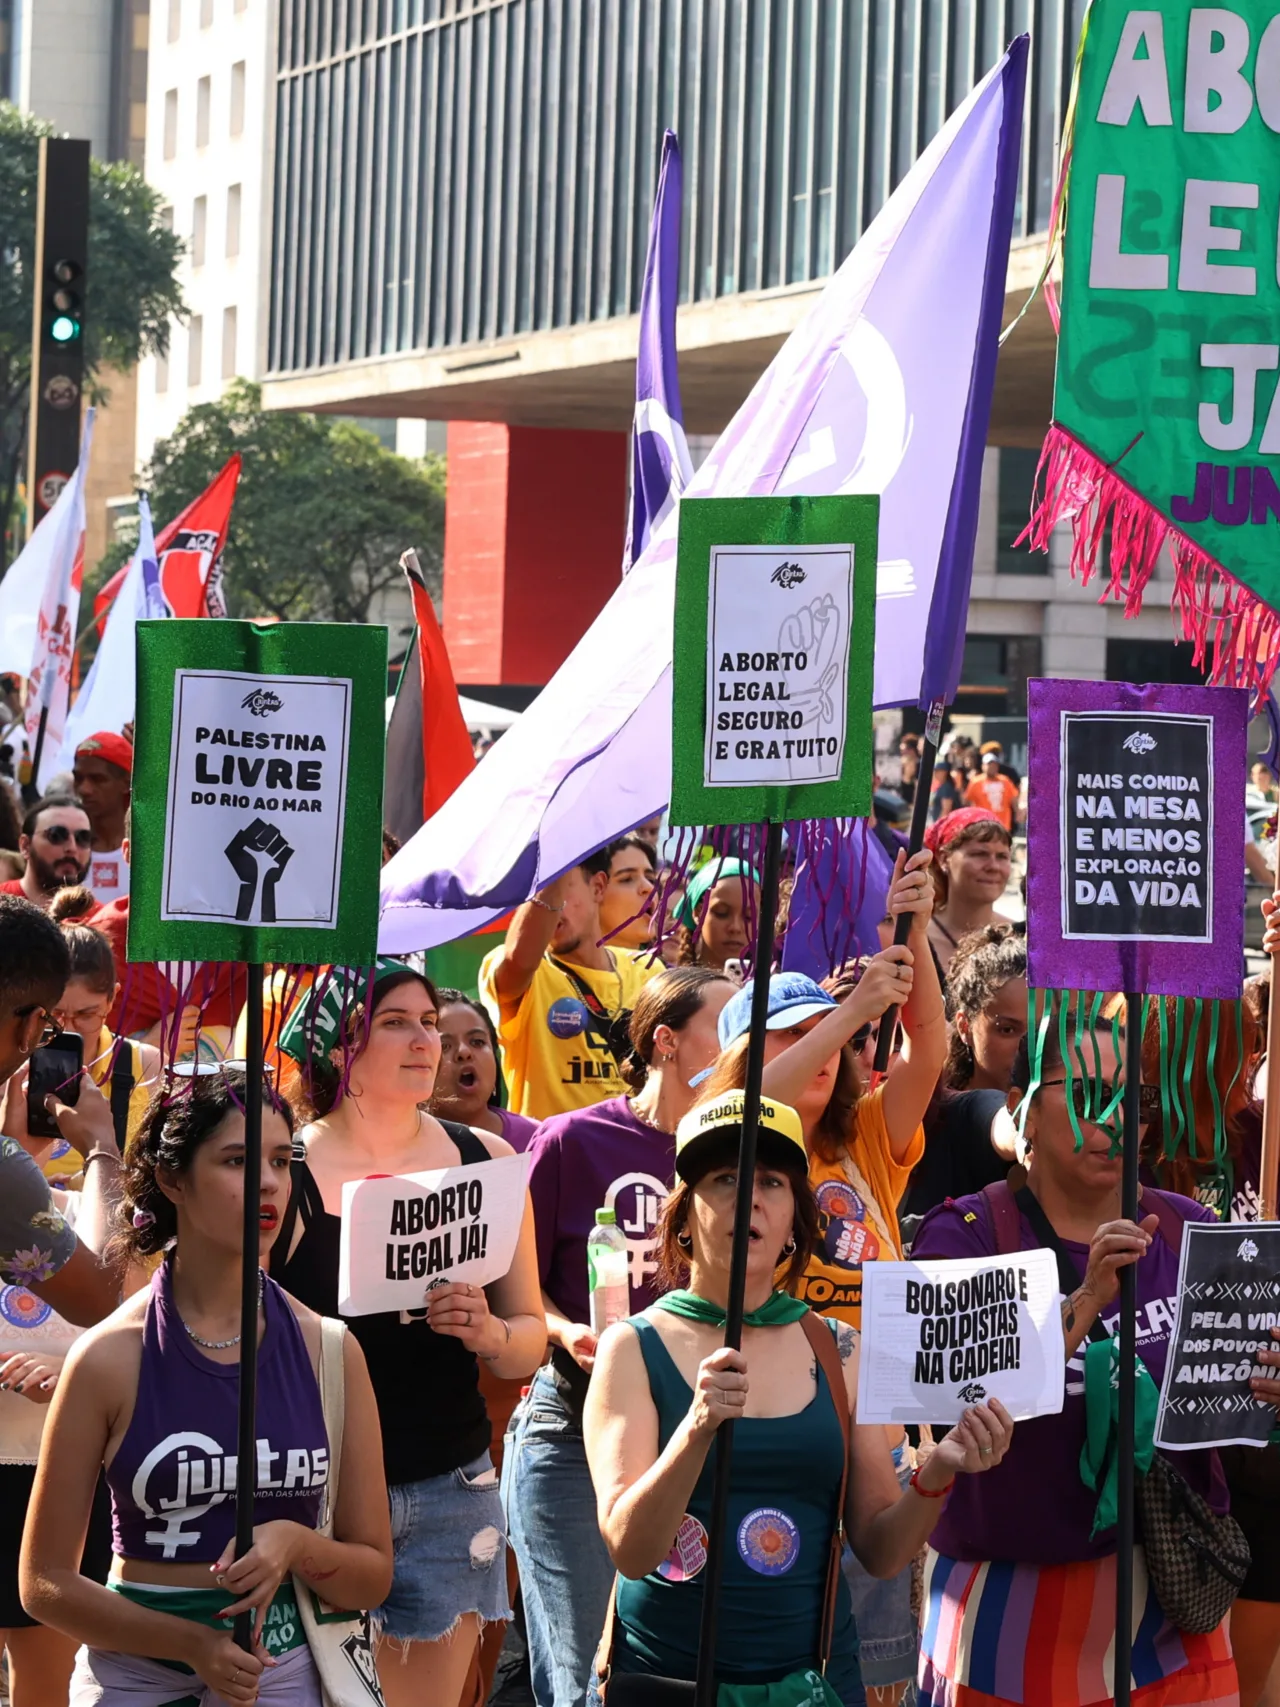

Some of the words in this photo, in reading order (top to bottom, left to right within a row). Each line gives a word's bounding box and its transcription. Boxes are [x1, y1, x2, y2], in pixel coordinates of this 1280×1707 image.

[719, 652, 808, 672] ABORTO
[718, 681, 790, 702] LEGAL
[717, 710, 803, 731] SEGURO
[195, 727, 326, 752] PALESTINA
[715, 741, 728, 760] E
[735, 736, 837, 760] GRATUITO
[195, 752, 323, 791] LIVRE
[1077, 773, 1124, 790] MAIS
[1128, 774, 1200, 792] COMIDA
[191, 791, 217, 805] DO
[220, 792, 250, 809] RIO
[253, 797, 279, 811] AO
[282, 798, 322, 812] MAR
[1076, 795, 1117, 820] NA
[1124, 796, 1202, 821] MESA
[1076, 827, 1094, 851] E
[1101, 828, 1201, 854] MENOS
[1075, 857, 1201, 879] EXPLORAÇÃO
[1075, 879, 1120, 906] DA
[1128, 880, 1202, 908] VIDA
[390, 1179, 483, 1236] ABORTO
[385, 1232, 454, 1281] LEGAL
[458, 1215, 488, 1265] JÁ!
[834, 1229, 852, 1260] NÃO
[847, 1227, 867, 1265] NÃO!
[832, 1289, 862, 1303] AN
[905, 1267, 1016, 1317] BOLSONARO
[1018, 1268, 1029, 1302] E
[920, 1301, 1018, 1351] GOLPISTAS
[1190, 1311, 1242, 1329] PELA
[1182, 1338, 1211, 1353] DOS
[1213, 1339, 1268, 1353] POVOS
[914, 1351, 944, 1384] NA
[949, 1336, 1020, 1383] CADEIA!
[275, 1489, 293, 1498] DAS
